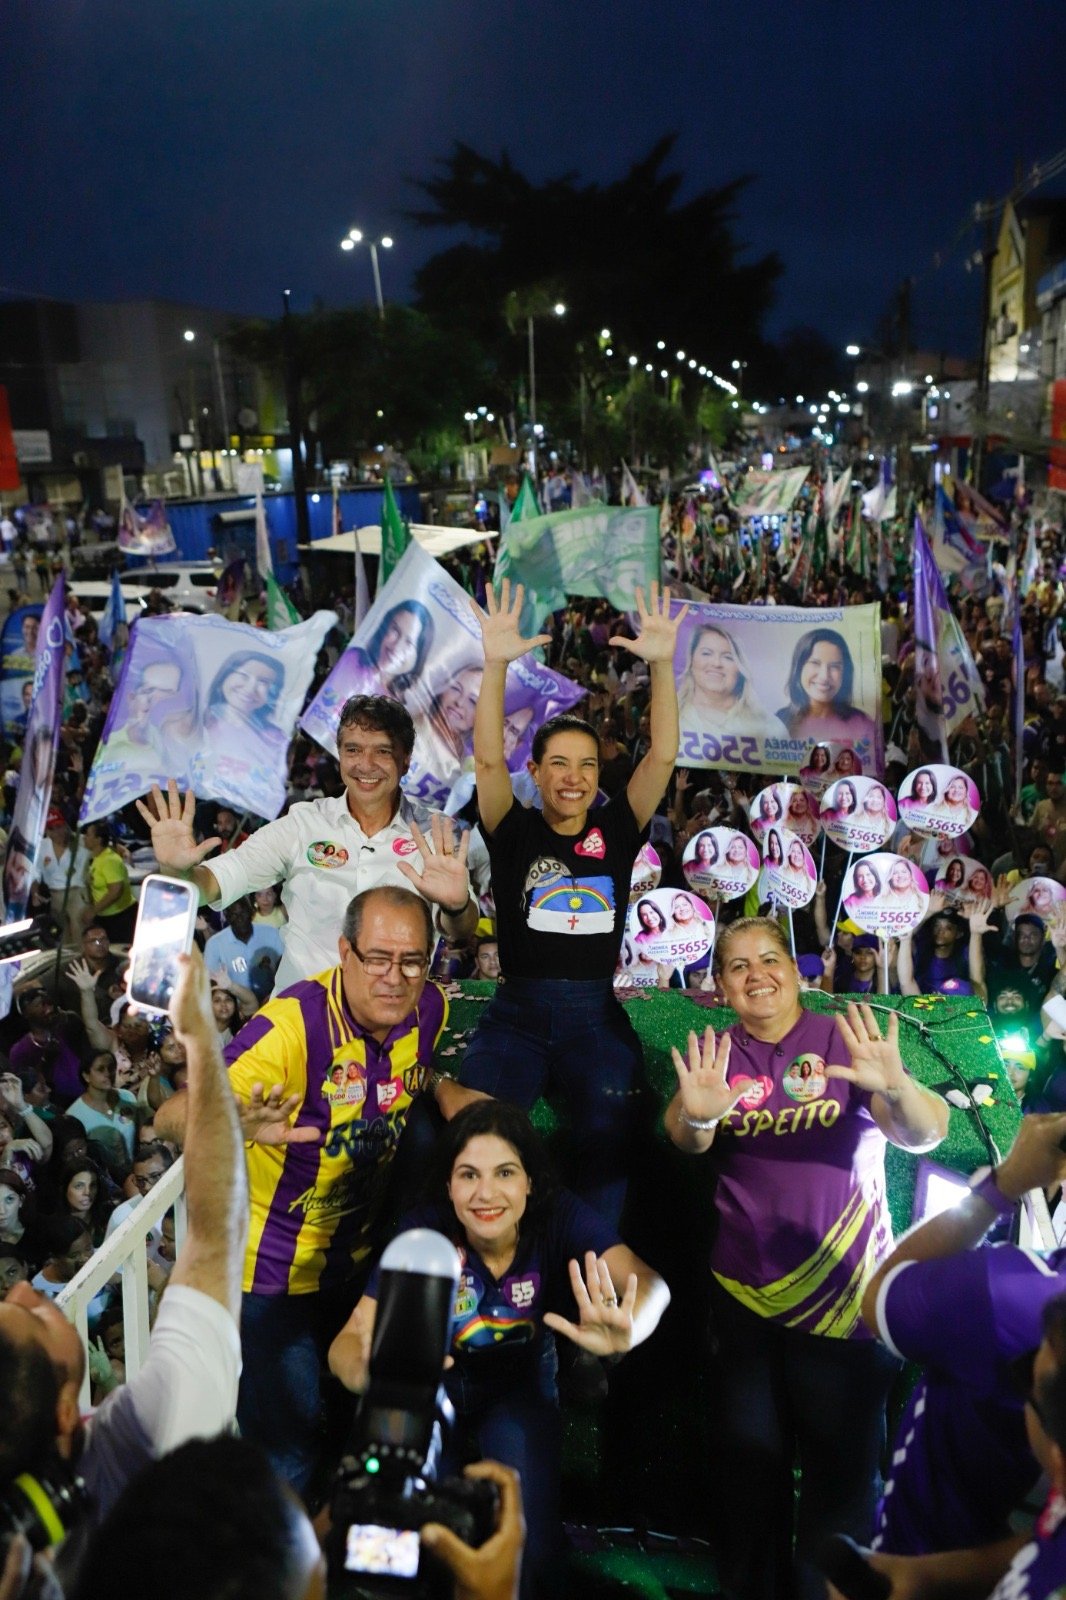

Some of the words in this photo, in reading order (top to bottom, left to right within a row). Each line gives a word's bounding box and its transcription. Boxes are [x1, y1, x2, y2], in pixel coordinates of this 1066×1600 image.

[926, 818, 965, 834] 55655
[848, 828, 885, 845] 55655
[630, 881, 654, 892] 655
[711, 879, 747, 893] 55655
[781, 882, 808, 903] 55655
[670, 939, 709, 956] 55655
[721, 1099, 840, 1138] ESPEITO
[511, 1280, 535, 1303] 55
